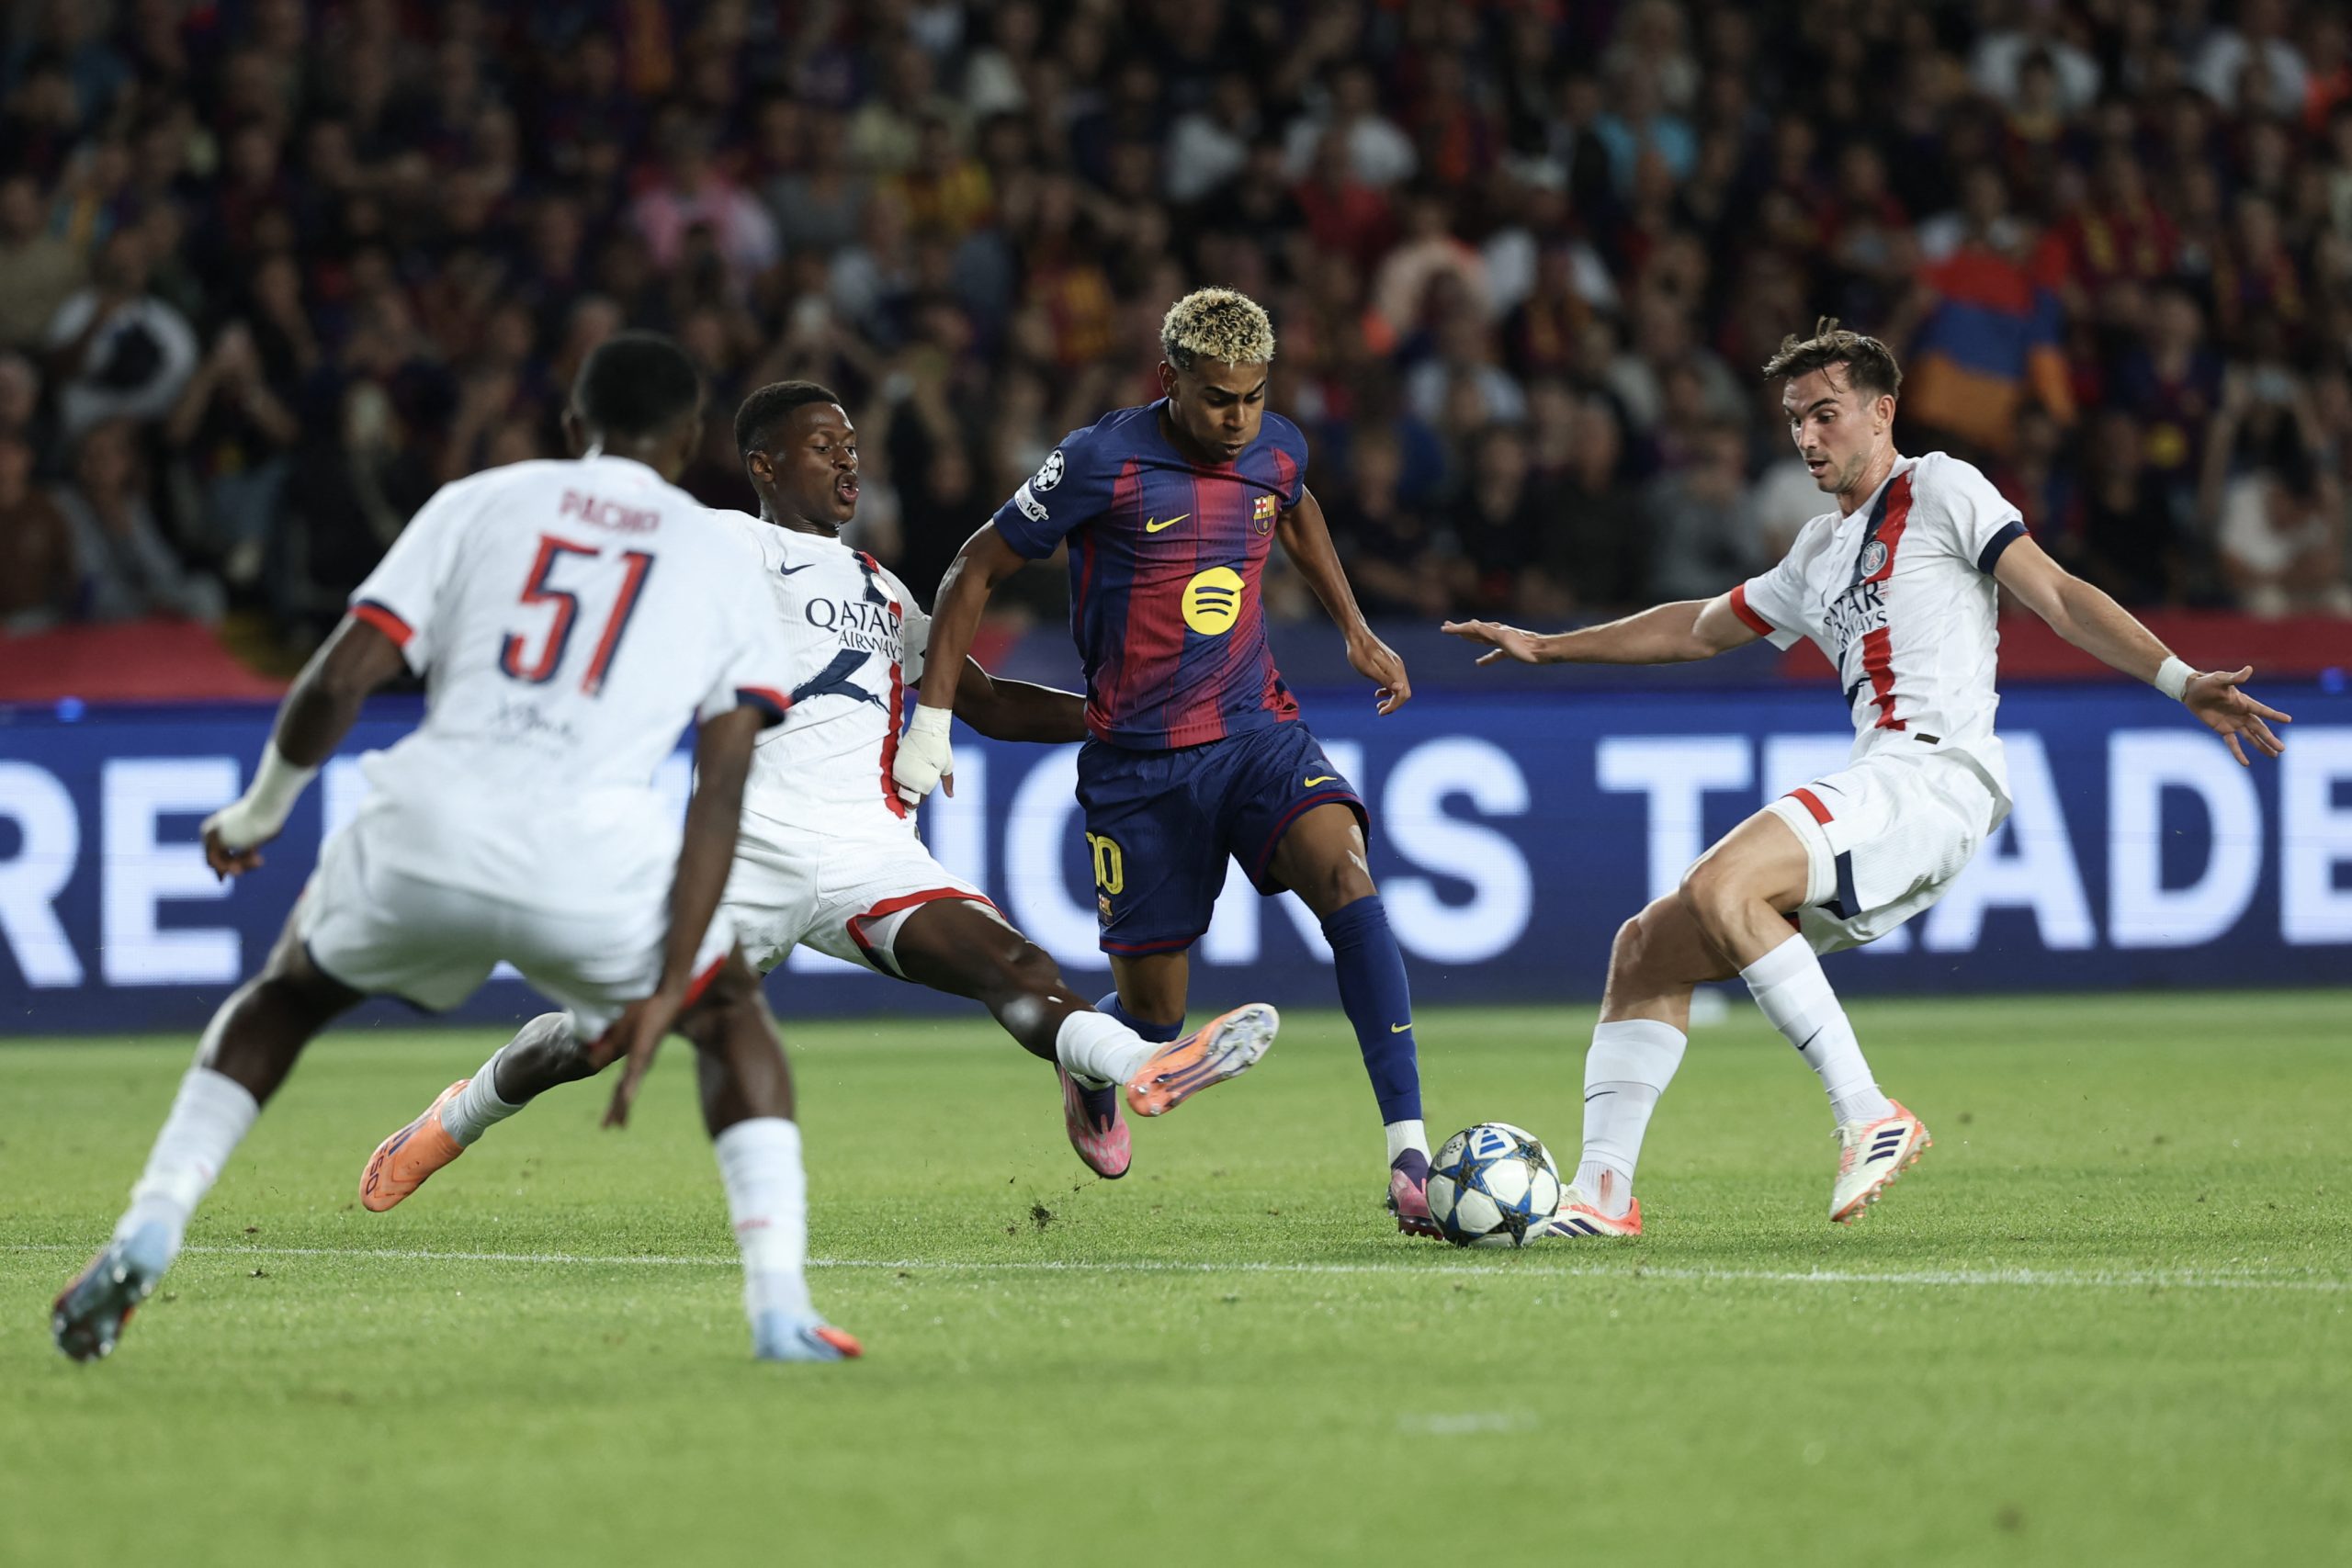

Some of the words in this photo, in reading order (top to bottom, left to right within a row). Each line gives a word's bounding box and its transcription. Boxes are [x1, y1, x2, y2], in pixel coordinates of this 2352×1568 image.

[560, 488, 661, 533] PACHO
[499, 531, 655, 700] 51
[806, 598, 900, 642] QATAR
[838, 629, 903, 664] AIRWAYS
